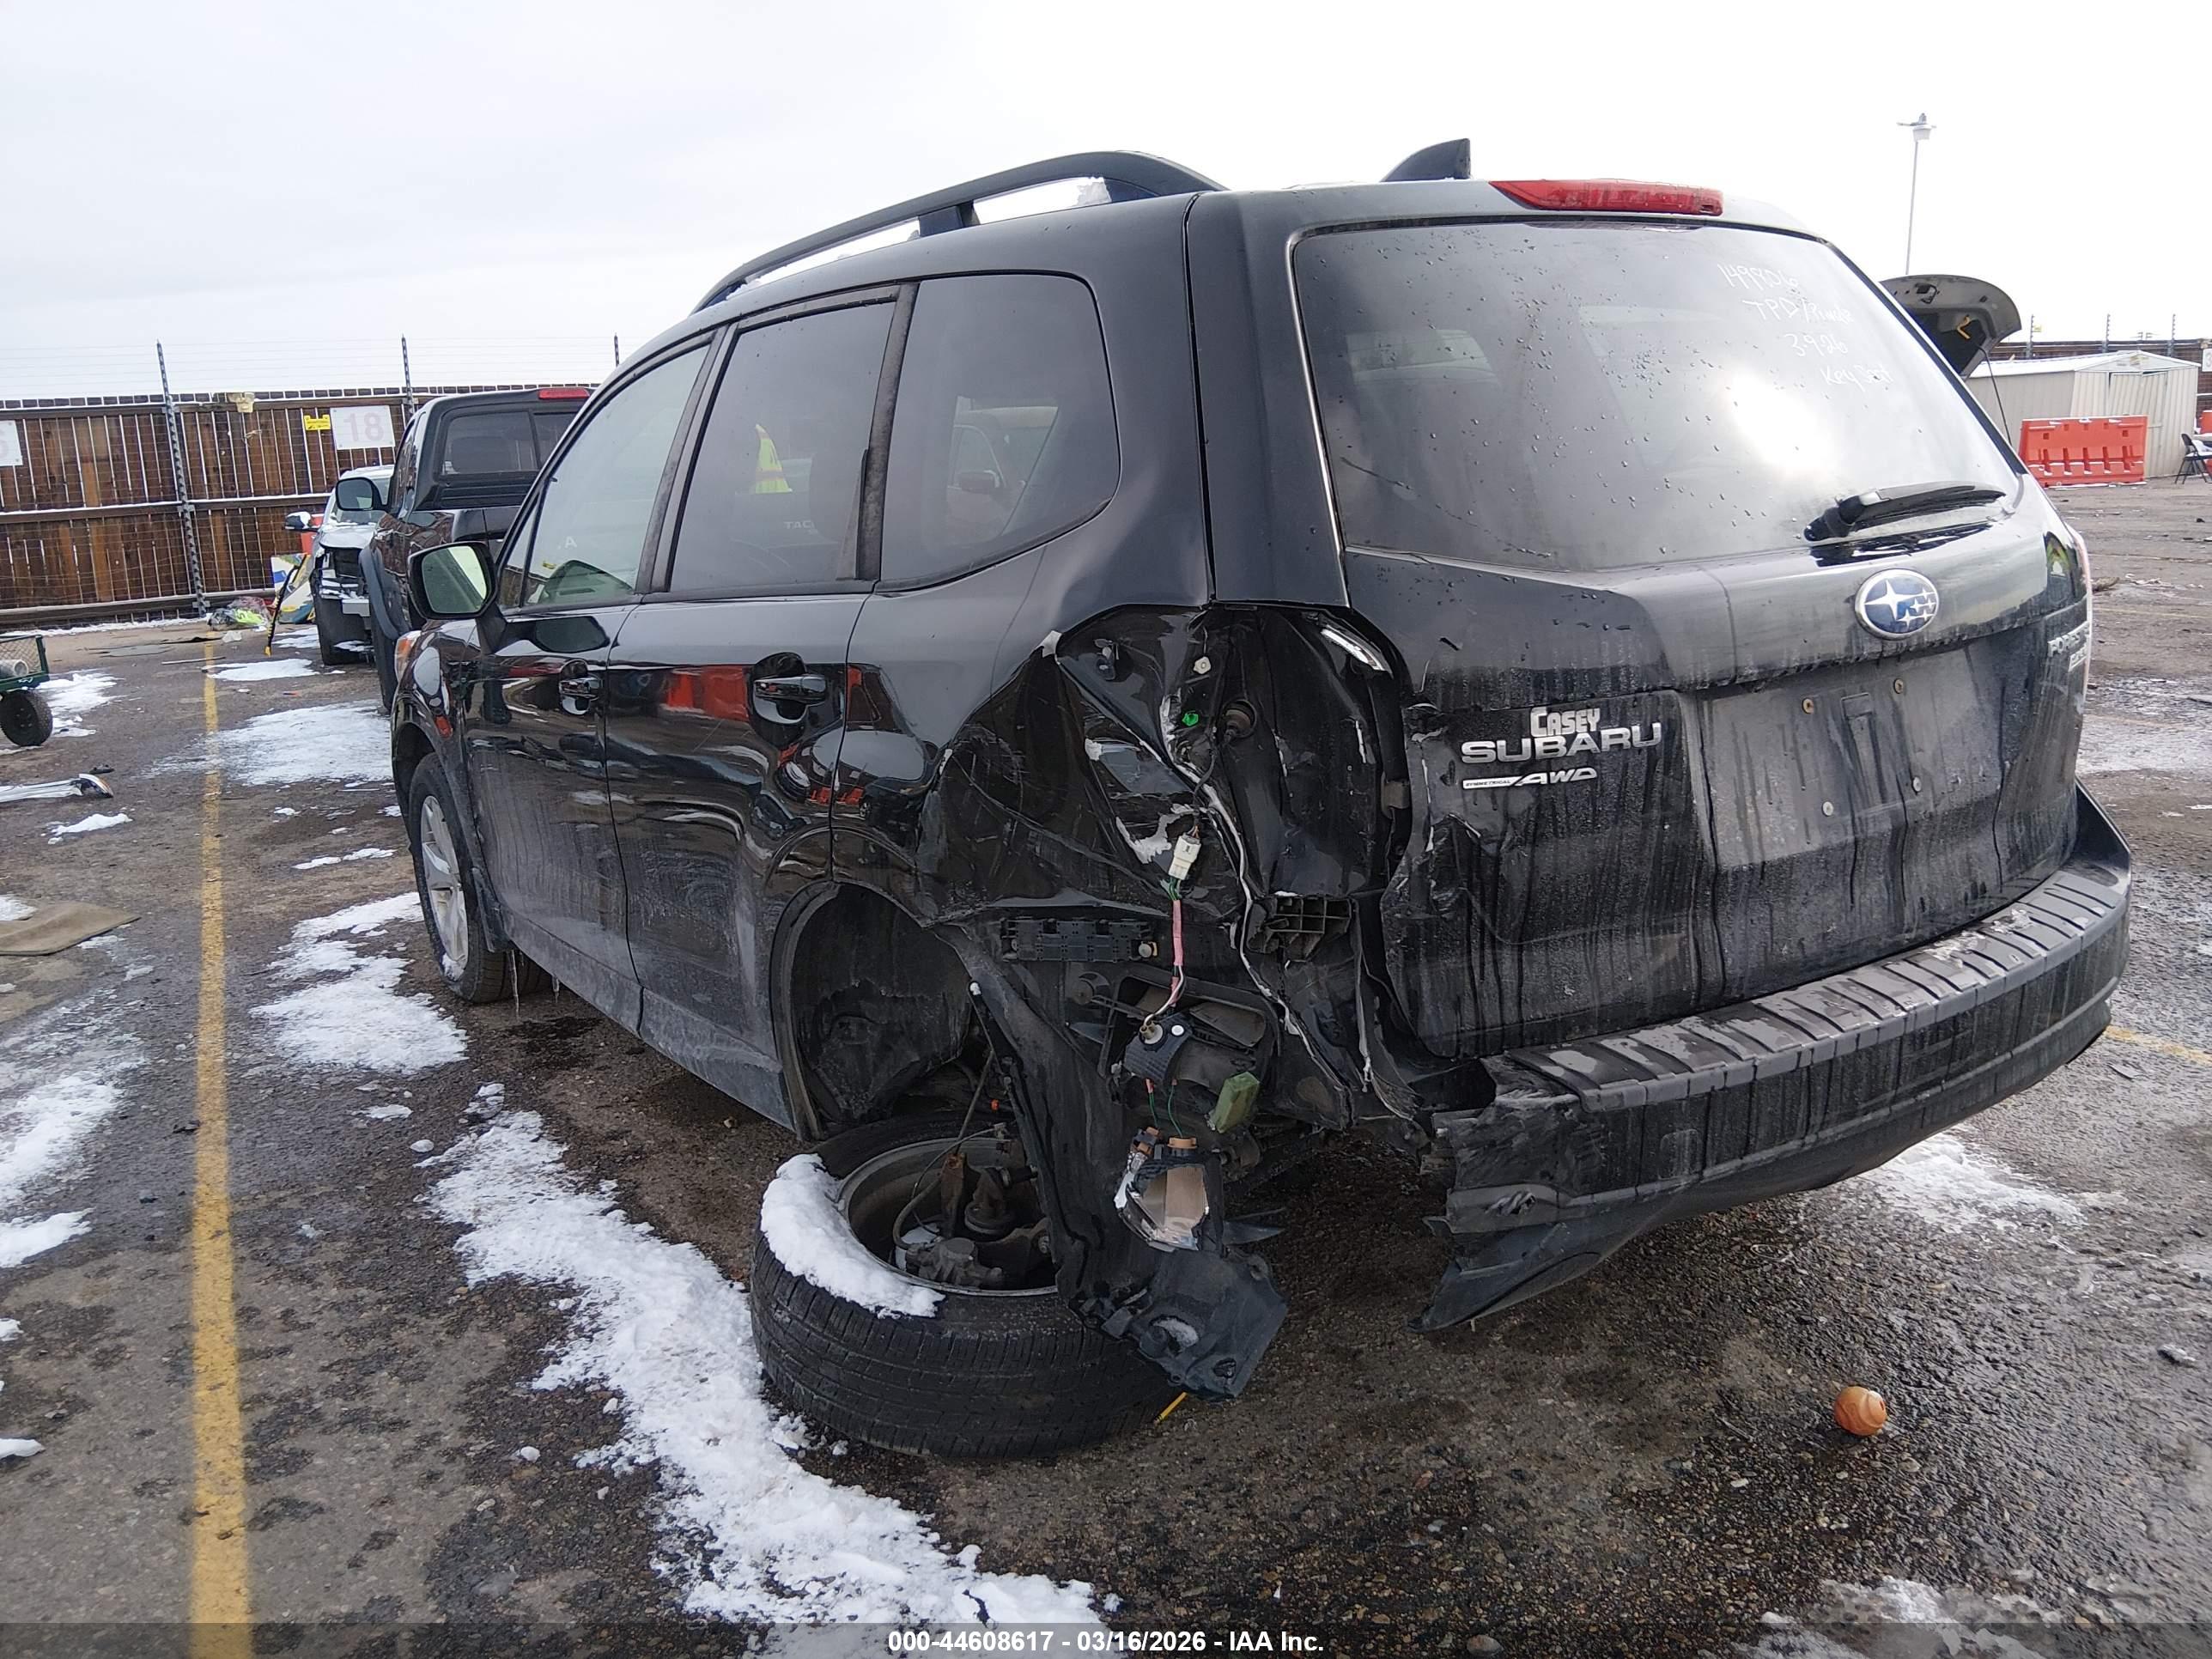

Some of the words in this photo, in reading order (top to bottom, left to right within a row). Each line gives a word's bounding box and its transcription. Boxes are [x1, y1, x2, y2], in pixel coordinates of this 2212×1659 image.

[343, 412, 385, 441] 18
[1530, 706, 1601, 738] CASEY
[1461, 722, 1662, 763] SUBARU
[1515, 767, 1597, 786] AWD
